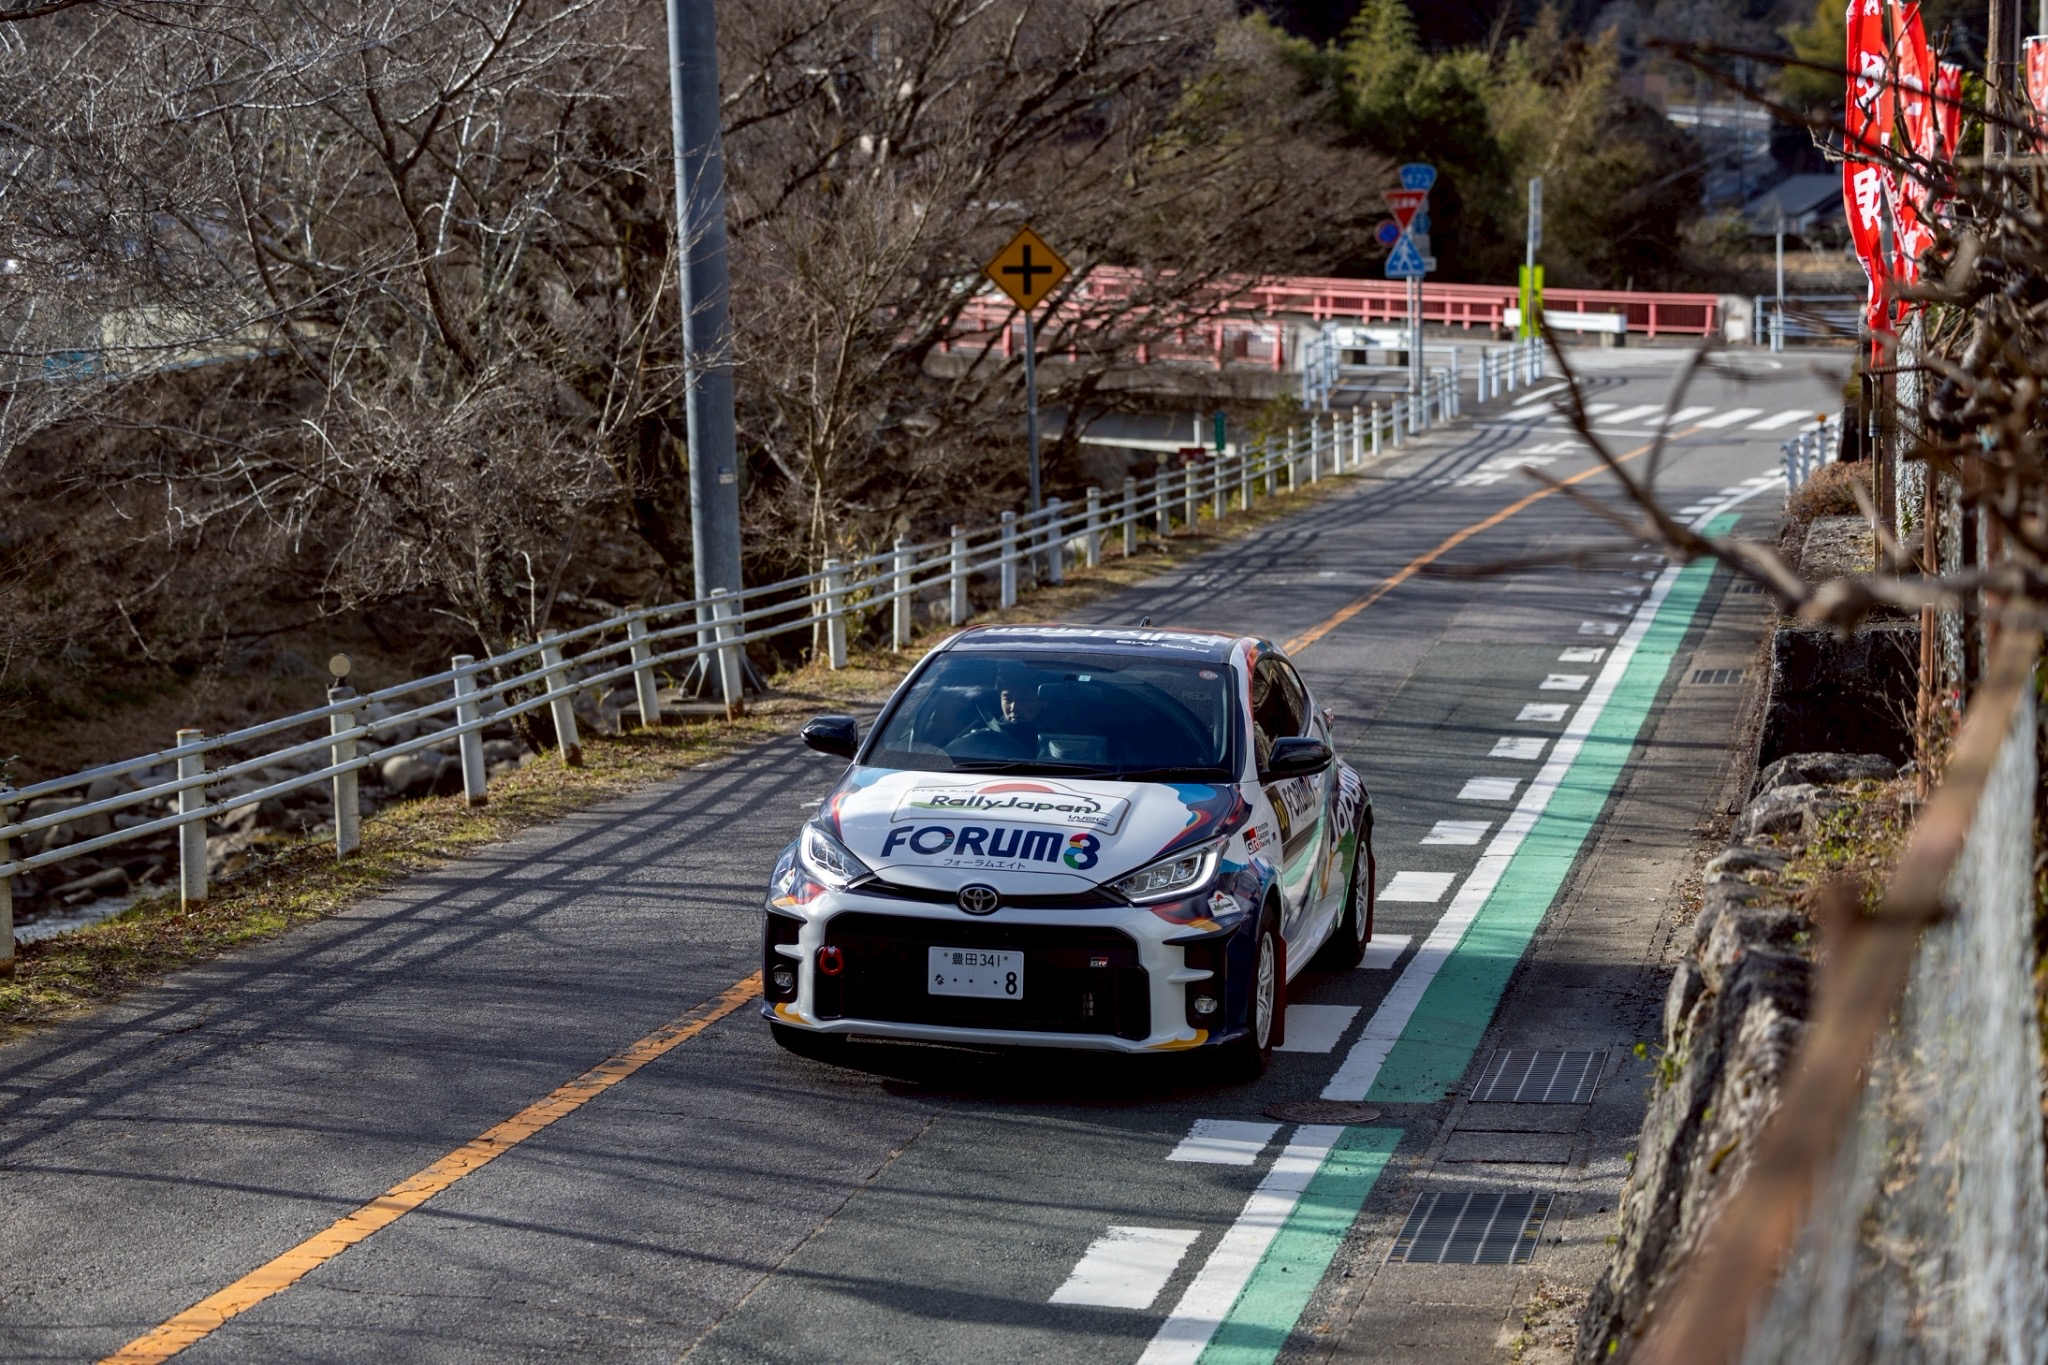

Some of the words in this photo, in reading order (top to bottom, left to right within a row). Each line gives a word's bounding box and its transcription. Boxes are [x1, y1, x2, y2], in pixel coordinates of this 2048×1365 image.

[880, 825, 1101, 870] FORUM8
[943, 857, 1026, 870] フォーラムエイト
[934, 973, 945, 985] な
